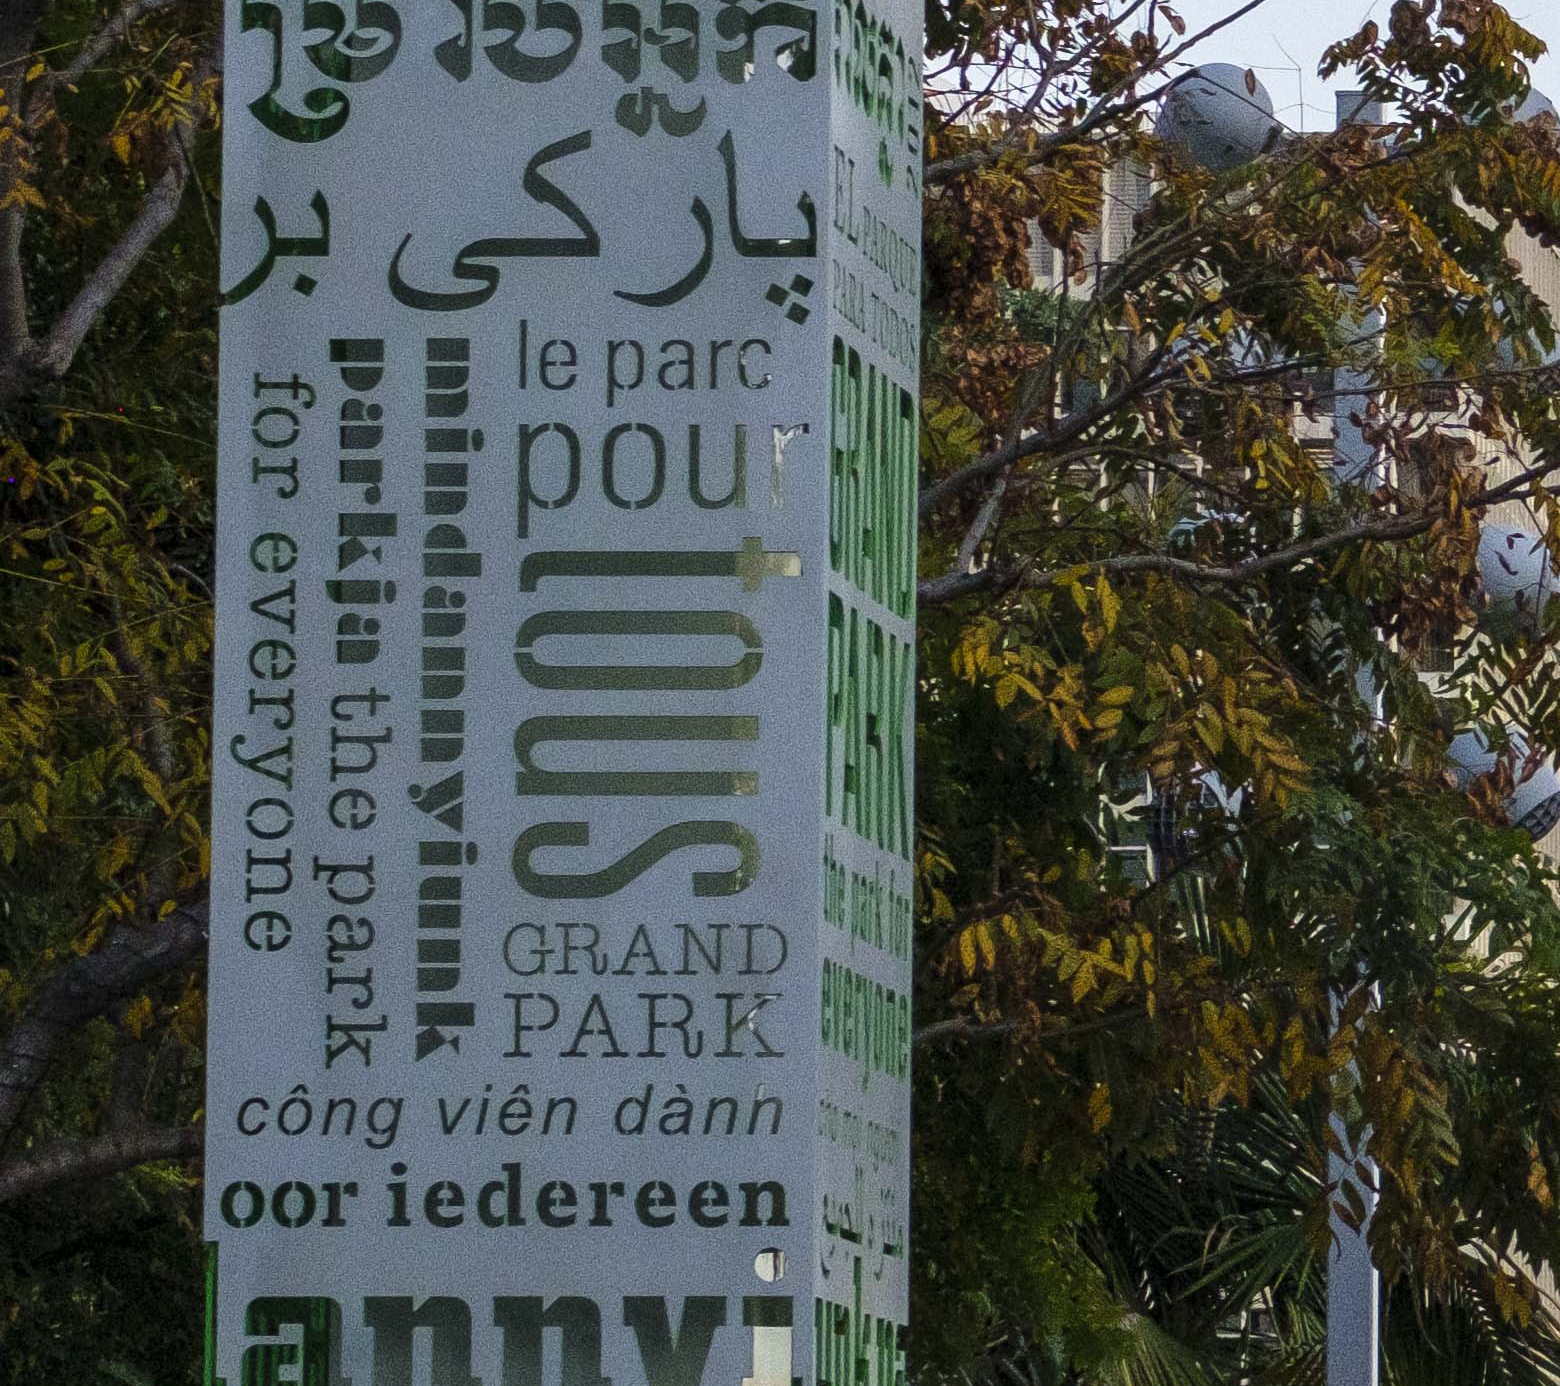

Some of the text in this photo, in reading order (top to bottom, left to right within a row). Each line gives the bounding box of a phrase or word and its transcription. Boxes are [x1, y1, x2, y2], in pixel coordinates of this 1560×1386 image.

[519, 320, 773, 407] le parc
[518, 423, 809, 539] pour
[231, 373, 315, 951] for everyone
[512, 536, 802, 899] tous
[313, 688, 392, 1069] the park
[503, 922, 788, 977] GRAND
[504, 992, 783, 1058] PARK
[237, 1084, 782, 1149] công viên dành
[221, 1162, 789, 1228] oor iedereen
